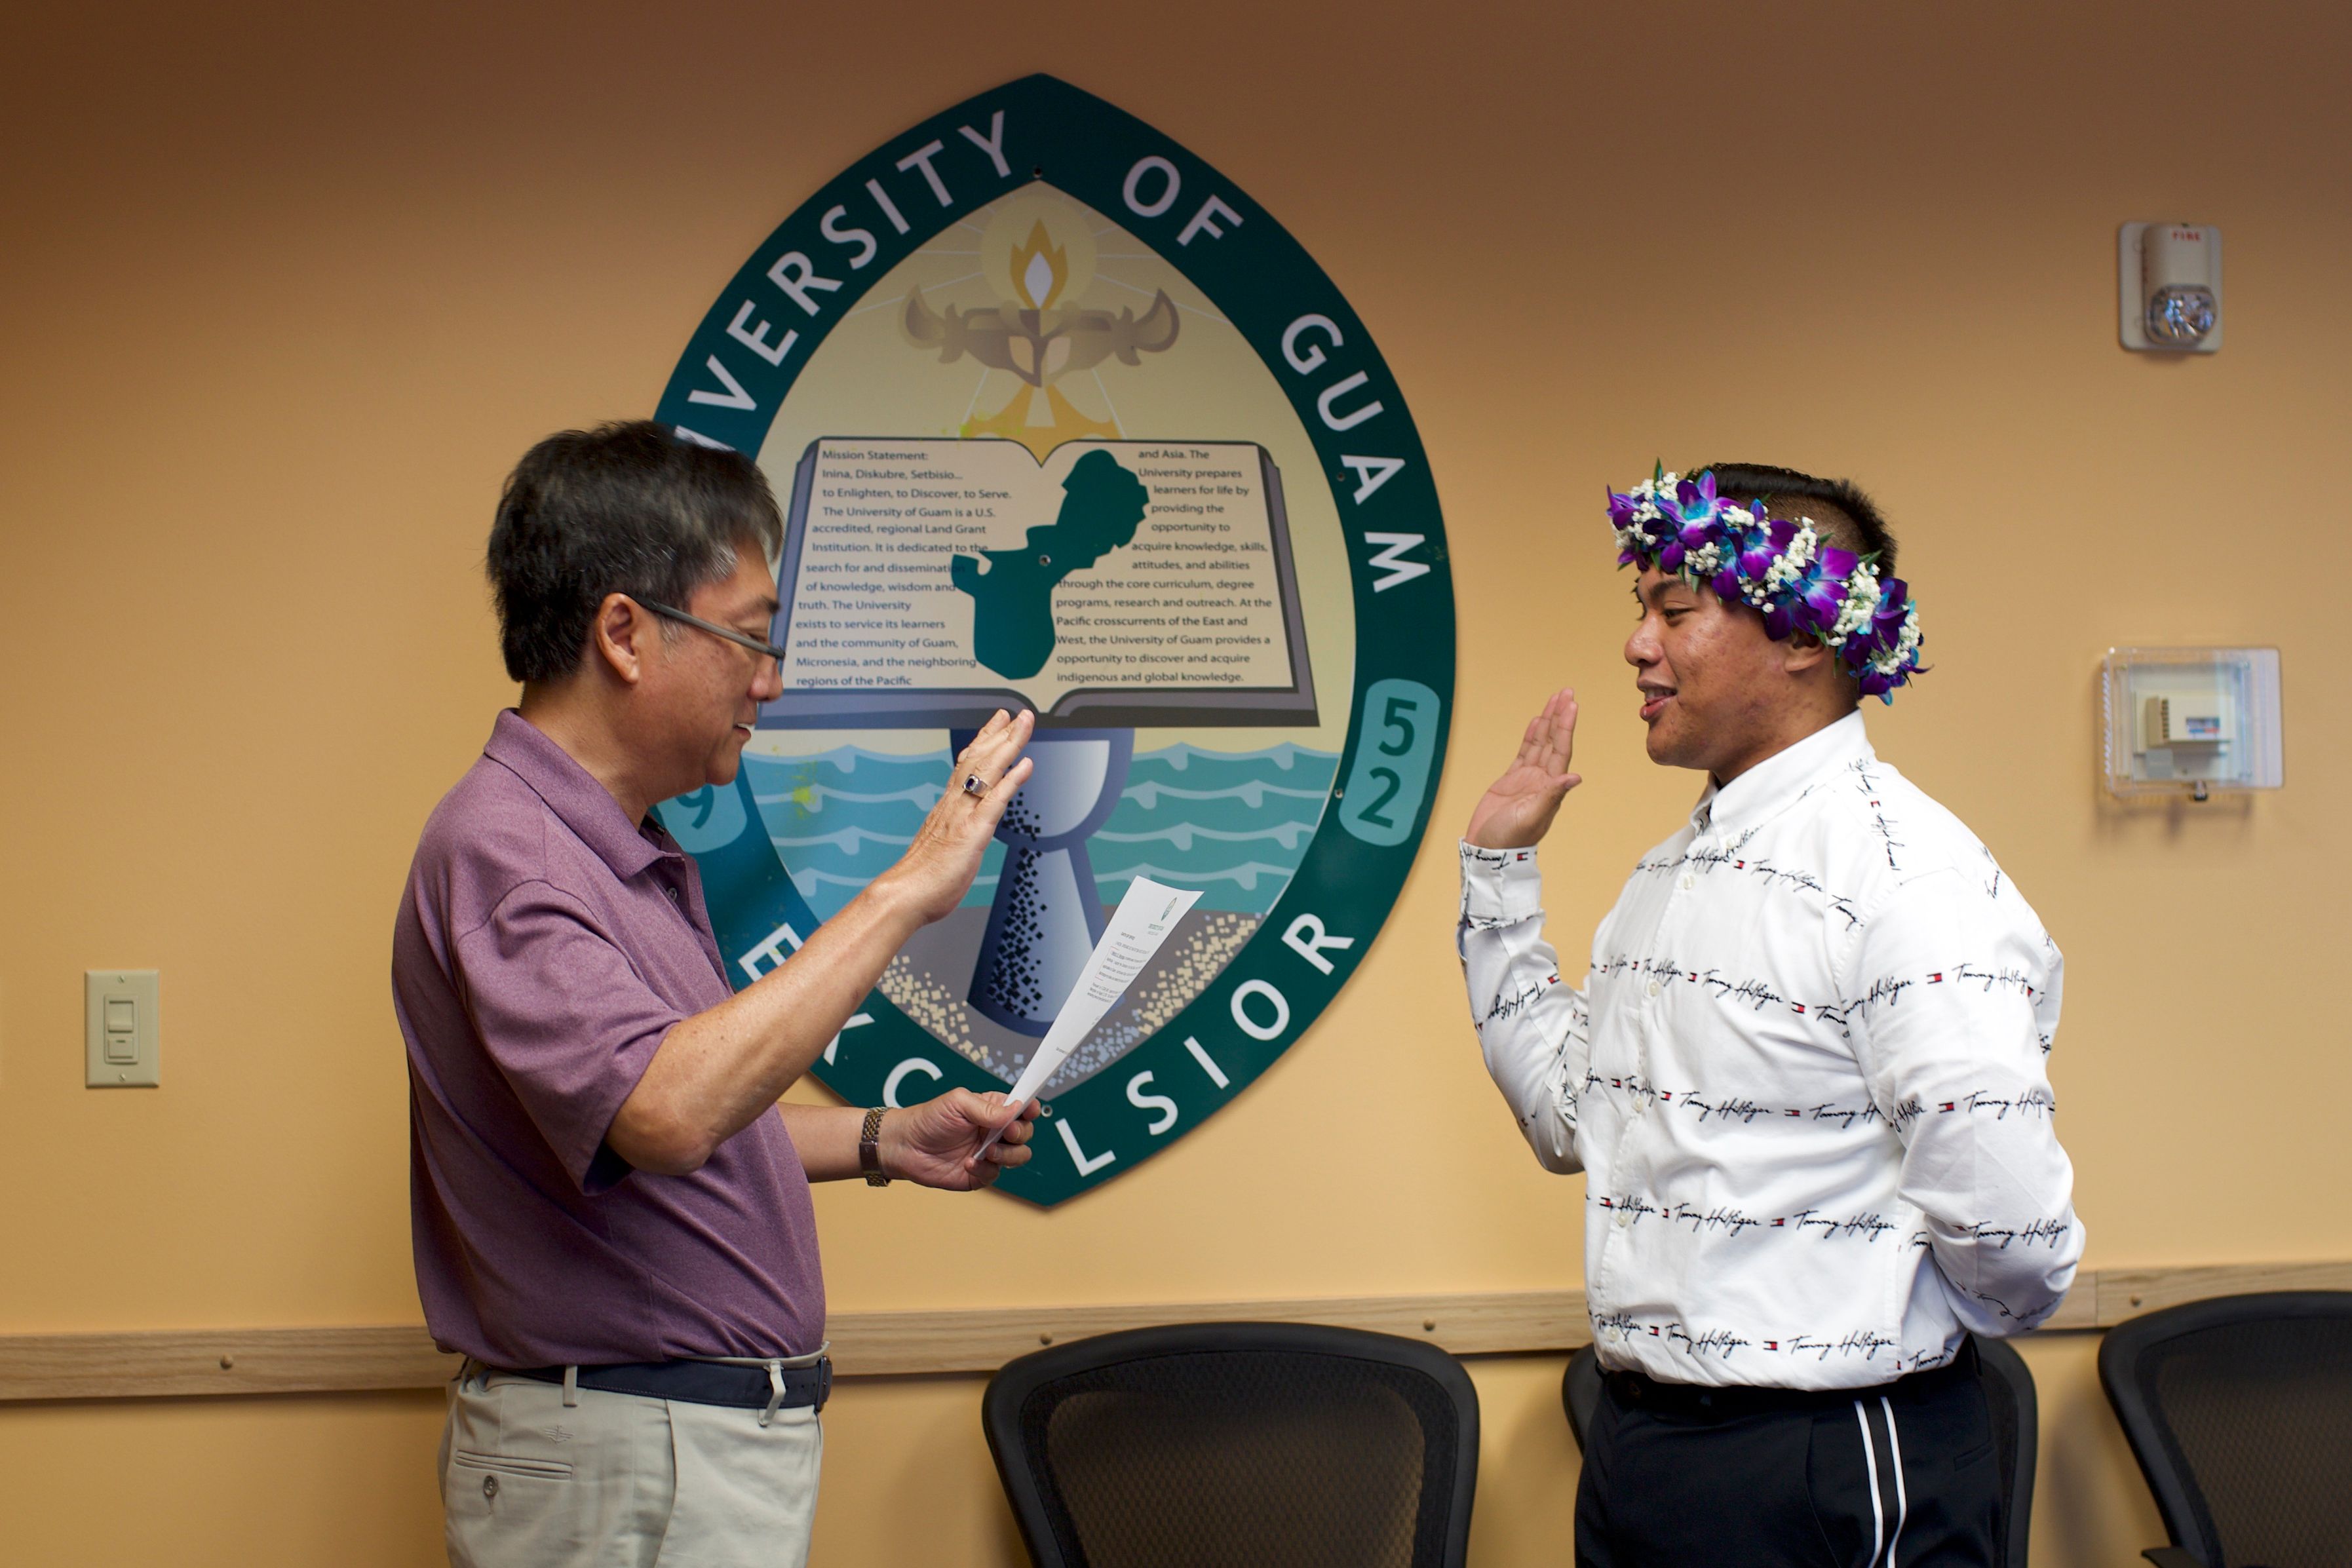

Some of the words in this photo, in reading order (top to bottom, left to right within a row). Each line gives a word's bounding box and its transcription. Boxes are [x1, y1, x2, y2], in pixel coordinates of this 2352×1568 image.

[1122, 155, 1244, 246] OF
[1281, 314, 1431, 593] GUAM
[822, 449, 864, 459] Mission
[868, 451, 928, 460] Statement:
[1138, 449, 1159, 459] and
[1162, 449, 1187, 459] Asia.
[1189, 449, 1210, 459] The
[822, 469, 853, 479] Inina,
[855, 469, 908, 480] Diskubre,
[1138, 469, 1193, 480] University
[1195, 470, 1243, 480] prepares
[822, 489, 835, 497] to
[838, 488, 894, 499] Enlighten,
[896, 489, 908, 498] to
[911, 488, 961, 499] Discover,
[963, 490, 976, 499] to
[978, 489, 1011, 499] Serve.
[1153, 485, 1197, 494] learners
[1199, 485, 1214, 495] for
[1217, 486, 1233, 495] life
[1235, 486, 1250, 497] by
[822, 507, 844, 516] The
[846, 507, 902, 518] University
[904, 507, 917, 516] of
[918, 507, 952, 517] Guam
[955, 508, 963, 517] is
[975, 508, 995, 518] U.S.
[1151, 503, 1204, 515] providing
[1206, 504, 1224, 513] the
[812, 524, 874, 534] accredited,
[876, 524, 923, 535] regional
[925, 524, 952, 533] Land
[955, 524, 986, 534] Grant
[1151, 523, 1216, 533] opportunity
[1218, 524, 1231, 532] to
[813, 543, 872, 552] Institution.
[876, 543, 883, 552] It
[886, 543, 895, 552] is
[896, 543, 952, 552] dedicated
[955, 544, 968, 552] to
[971, 543, 988, 552] the
[1131, 543, 1172, 552] acquire
[1174, 542, 1237, 553] knowledge,
[1240, 542, 1267, 552] skills,
[806, 563, 842, 573] search
[844, 563, 860, 573] for
[863, 564, 885, 573] and
[1132, 560, 1182, 570] attitudes,
[1186, 561, 1206, 569] and
[1208, 560, 1250, 570] abilities
[805, 582, 818, 591] of
[820, 582, 885, 594] knowledge,
[888, 582, 932, 592] wisdom
[935, 582, 957, 591] and
[1106, 579, 1124, 588] the
[1153, 579, 1214, 589] curriculum,
[1216, 579, 1254, 591] degree
[798, 600, 829, 609] truth.
[832, 600, 853, 609] The
[856, 601, 912, 611] University
[1056, 599, 1111, 609] programs,
[1114, 598, 1160, 607] research
[1163, 598, 1183, 607] and
[1186, 598, 1237, 607] outreach.
[1239, 598, 1251, 607] At
[1254, 598, 1272, 607] the
[796, 620, 827, 629] exists
[829, 621, 841, 629] to
[844, 620, 883, 629] service
[885, 619, 898, 628] its
[901, 619, 946, 629] learners
[1056, 616, 1091, 626] Pacific
[1168, 616, 1180, 626] of
[1182, 617, 1200, 626] the
[1203, 617, 1224, 626] East
[1227, 617, 1248, 626] and
[796, 638, 817, 647] and
[820, 638, 839, 647] the
[841, 639, 906, 649] community
[908, 638, 920, 647] of
[922, 638, 958, 648] Guam,
[1056, 635, 1086, 645] West,
[1089, 635, 1108, 644] the
[1110, 636, 1164, 646] University
[1166, 635, 1178, 644] of
[1180, 635, 1212, 644] Guam
[1215, 635, 1262, 646] provides
[796, 657, 859, 667] Micronesia,
[862, 657, 883, 666] and
[886, 657, 905, 666] the
[908, 657, 977, 668] neighboring
[1056, 655, 1123, 665] opportunity
[1139, 653, 1184, 663] discover
[1187, 654, 1208, 663] and
[1210, 654, 1250, 664] acquire
[796, 678, 838, 688] regions
[841, 677, 851, 685] of
[855, 677, 874, 685] the
[876, 677, 912, 685] Pacific
[1057, 672, 1118, 684] indigenous
[1121, 672, 1142, 681] and
[1144, 672, 1178, 683] global
[1181, 672, 1244, 683] knowledge.
[1952, 963, 1996, 992] Tommy
[1680, 1091, 1713, 1122] Tommy
[1714, 1098, 1773, 1123] Hilfiger
[1809, 1103, 1859, 1129] Tommy
[1963, 1090, 2012, 1120] Tommy
[1674, 1203, 1704, 1233] Tommy
[1704, 1206, 1762, 1237] Hilfiger
[1793, 1210, 1841, 1239] Tommy
[1842, 1212, 1899, 1242] Hilfiger
[1967, 1221, 2017, 1249] Tommy
[1665, 1323, 1695, 1354] Tommy
[1695, 1328, 1753, 1359] Hilfiger
[1787, 1335, 1833, 1361] Tommy
[1837, 1329, 1896, 1360] Hilfiger
